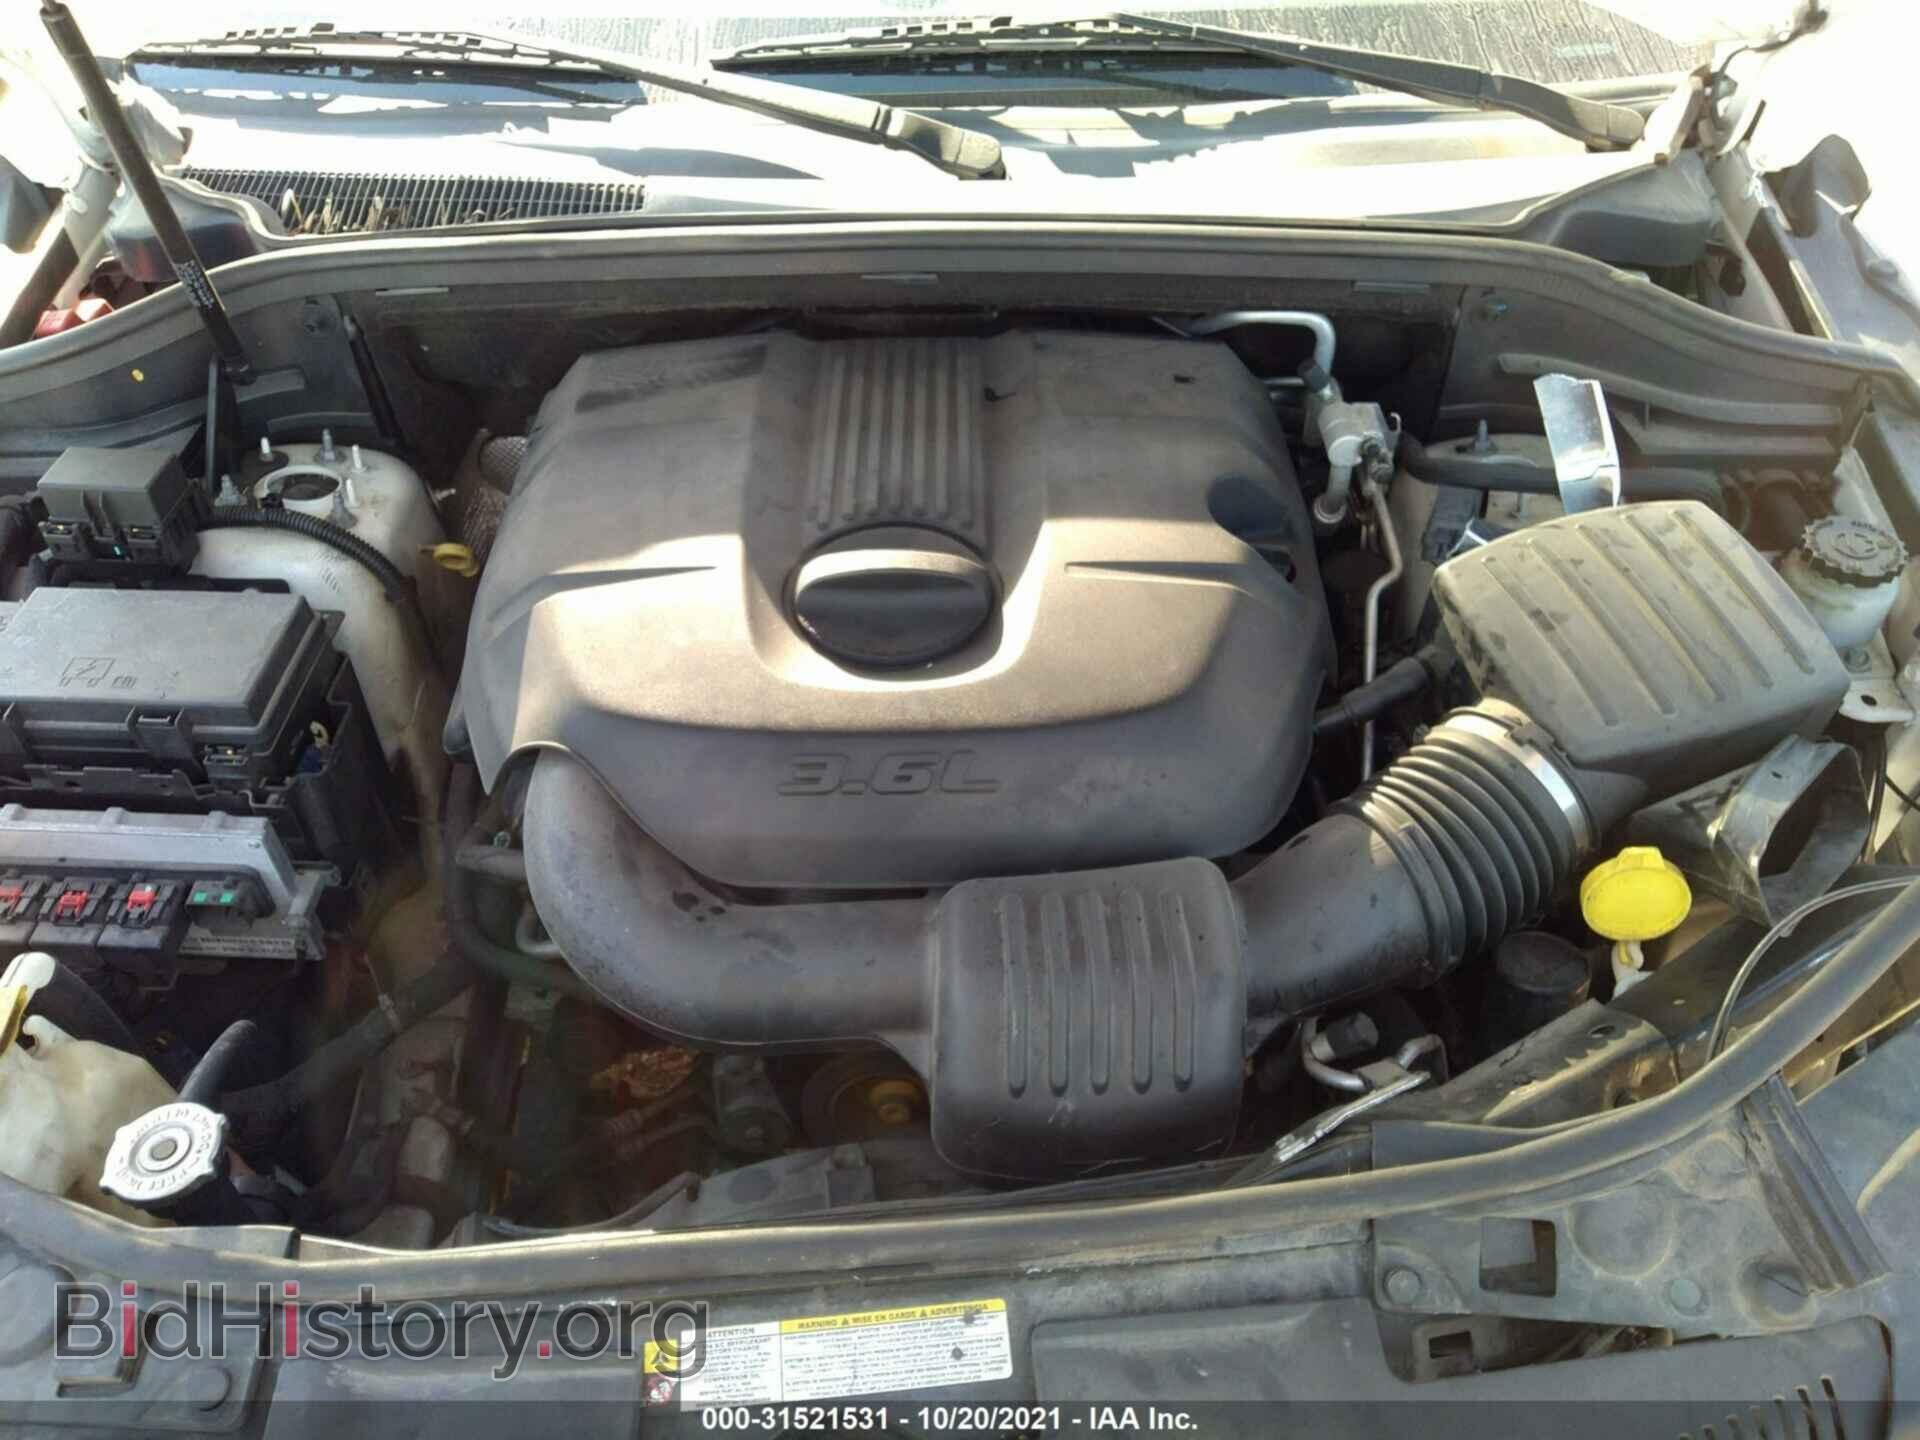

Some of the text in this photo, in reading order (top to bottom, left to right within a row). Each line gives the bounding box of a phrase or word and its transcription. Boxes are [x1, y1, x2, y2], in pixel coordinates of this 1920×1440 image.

[778, 750, 1001, 796] 3.6L
[798, 1319, 838, 1329] WARNING
[707, 1327, 755, 1338] ATTENTION
